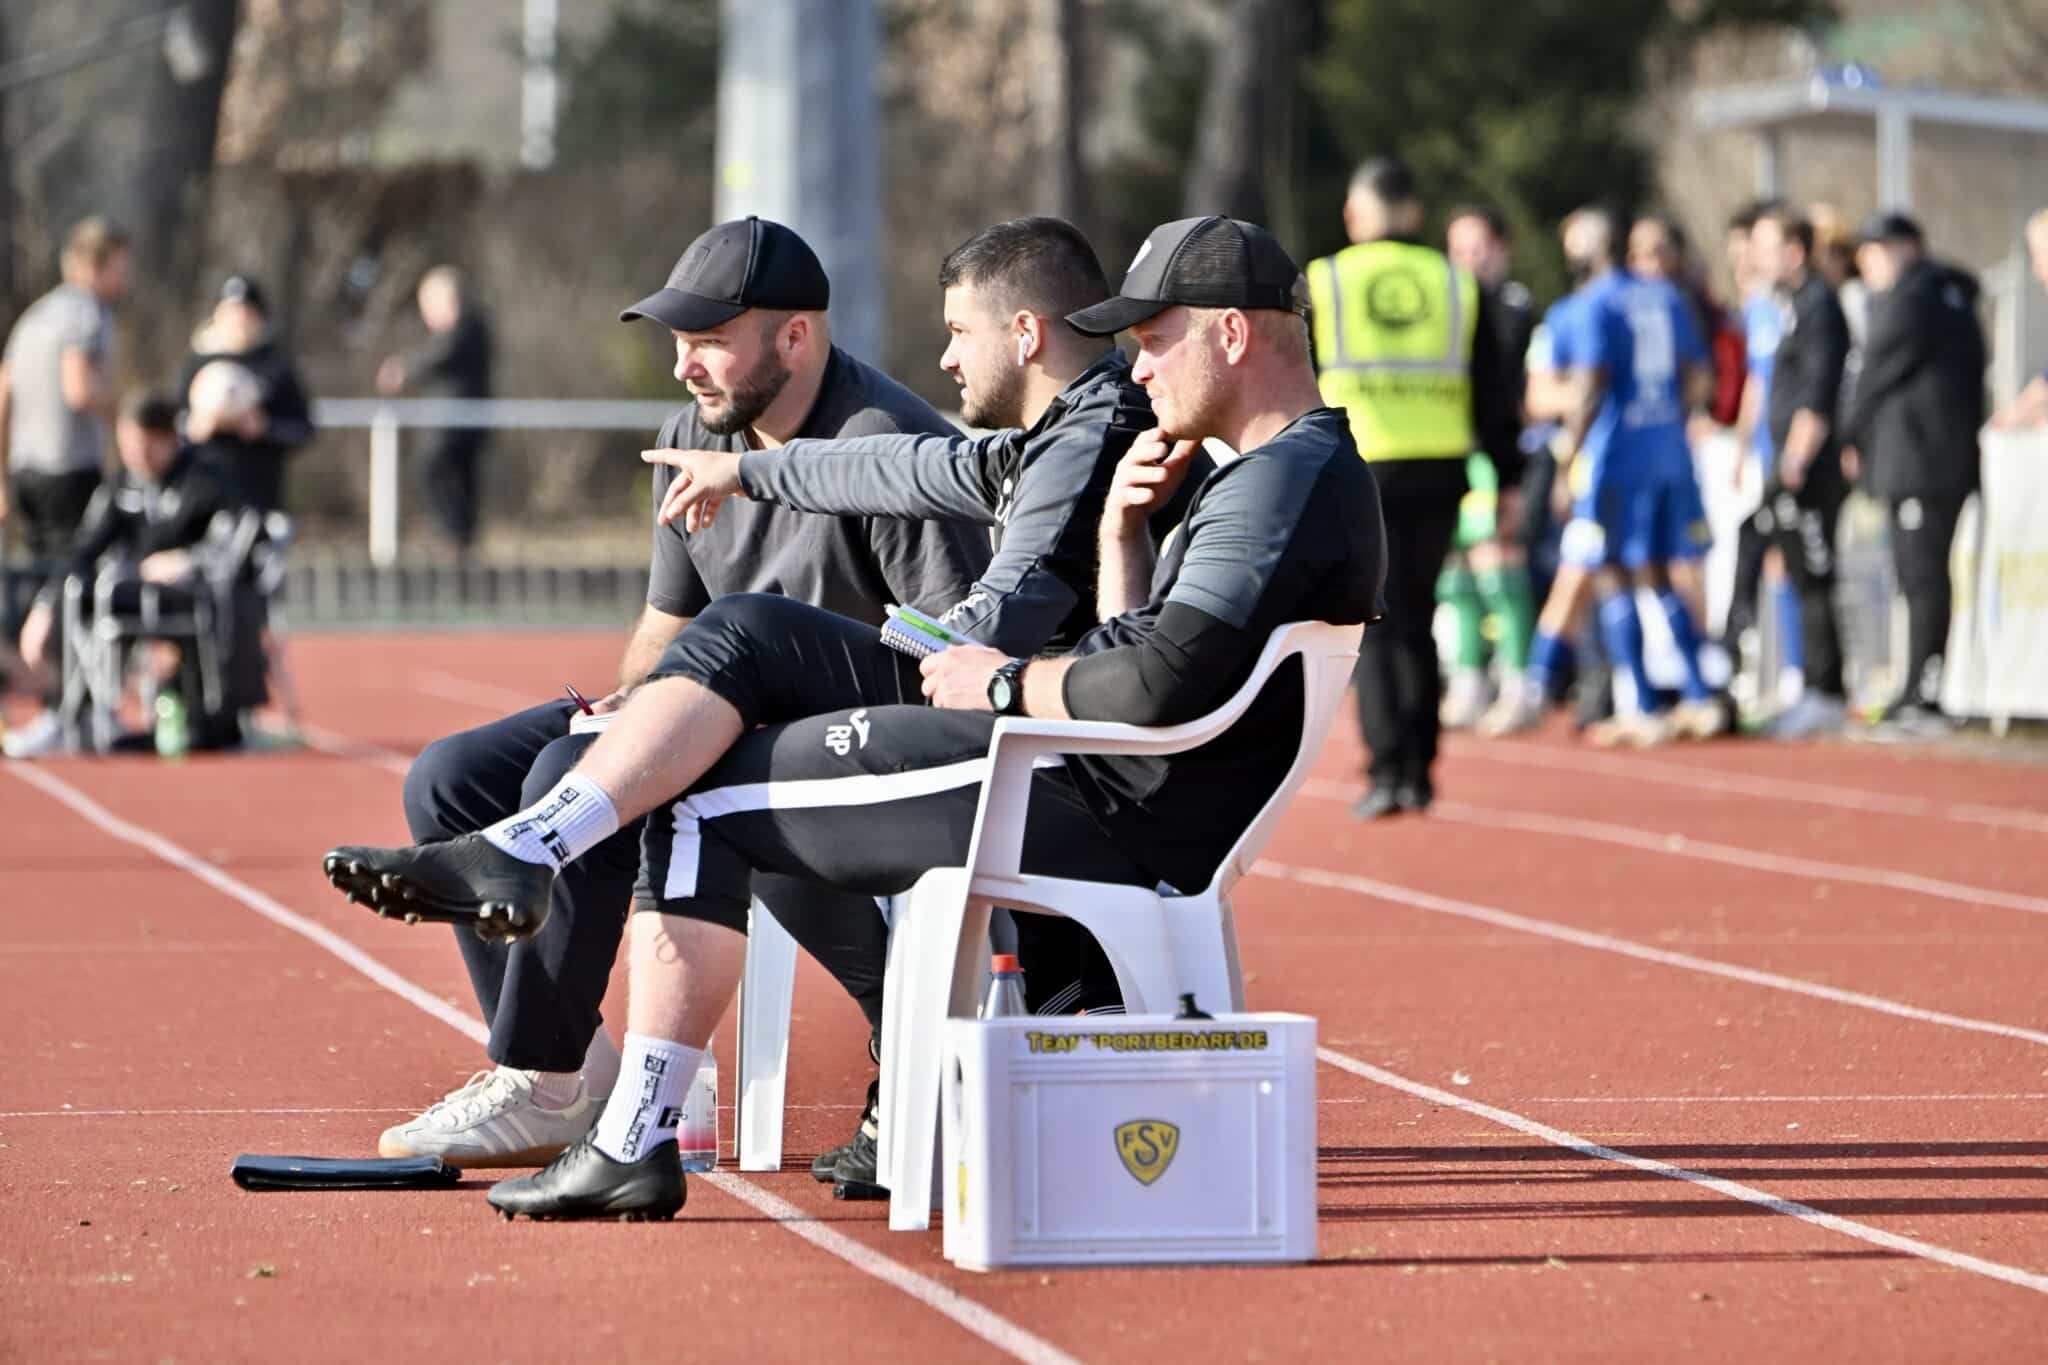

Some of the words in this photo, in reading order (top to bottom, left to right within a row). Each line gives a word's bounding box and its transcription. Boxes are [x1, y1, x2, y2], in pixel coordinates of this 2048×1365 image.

[825, 725, 852, 756] RP
[1025, 1031, 1267, 1053] TEAPORTBEDARF.DE
[1123, 1125, 1173, 1166] FSV
